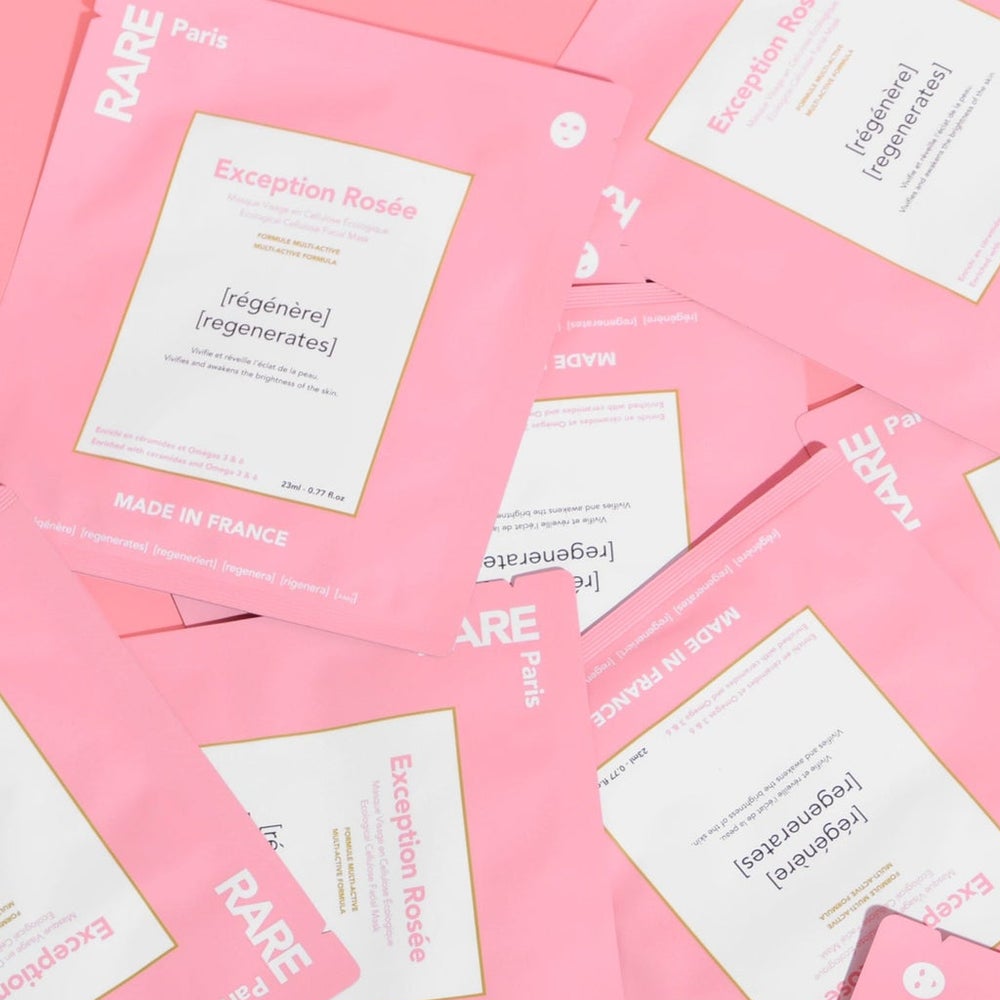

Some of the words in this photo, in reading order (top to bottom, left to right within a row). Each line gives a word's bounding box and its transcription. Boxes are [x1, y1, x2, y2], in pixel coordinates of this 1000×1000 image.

[93, 3, 164, 123] RARE
[170, 16, 228, 49] Paris
[706, 35, 788, 134] Exception
[844, 62, 919, 156] [régénère]
[861, 61, 953, 181] [regenerates]
[213, 157, 336, 203] Exception
[341, 185, 417, 220] Rosée
[194, 309, 338, 358] [regenerates]
[219, 286, 331, 328] [régénère]
[555, 352, 617, 369] MADE
[113, 491, 175, 520] MADE
[178, 506, 203, 526] IN
[206, 513, 289, 547] FRANCE
[455, 604, 541, 648] ARE
[683, 606, 741, 654] MADE
[519, 650, 544, 708] Paris
[660, 648, 686, 672] IN
[589, 665, 663, 727] FRANCE
[389, 753, 421, 880] Exception
[732, 771, 862, 879] [regenerates]
[764, 804, 868, 890] [régénère]
[214, 868, 312, 984] RARE
[402, 885, 430, 963] Rosée
